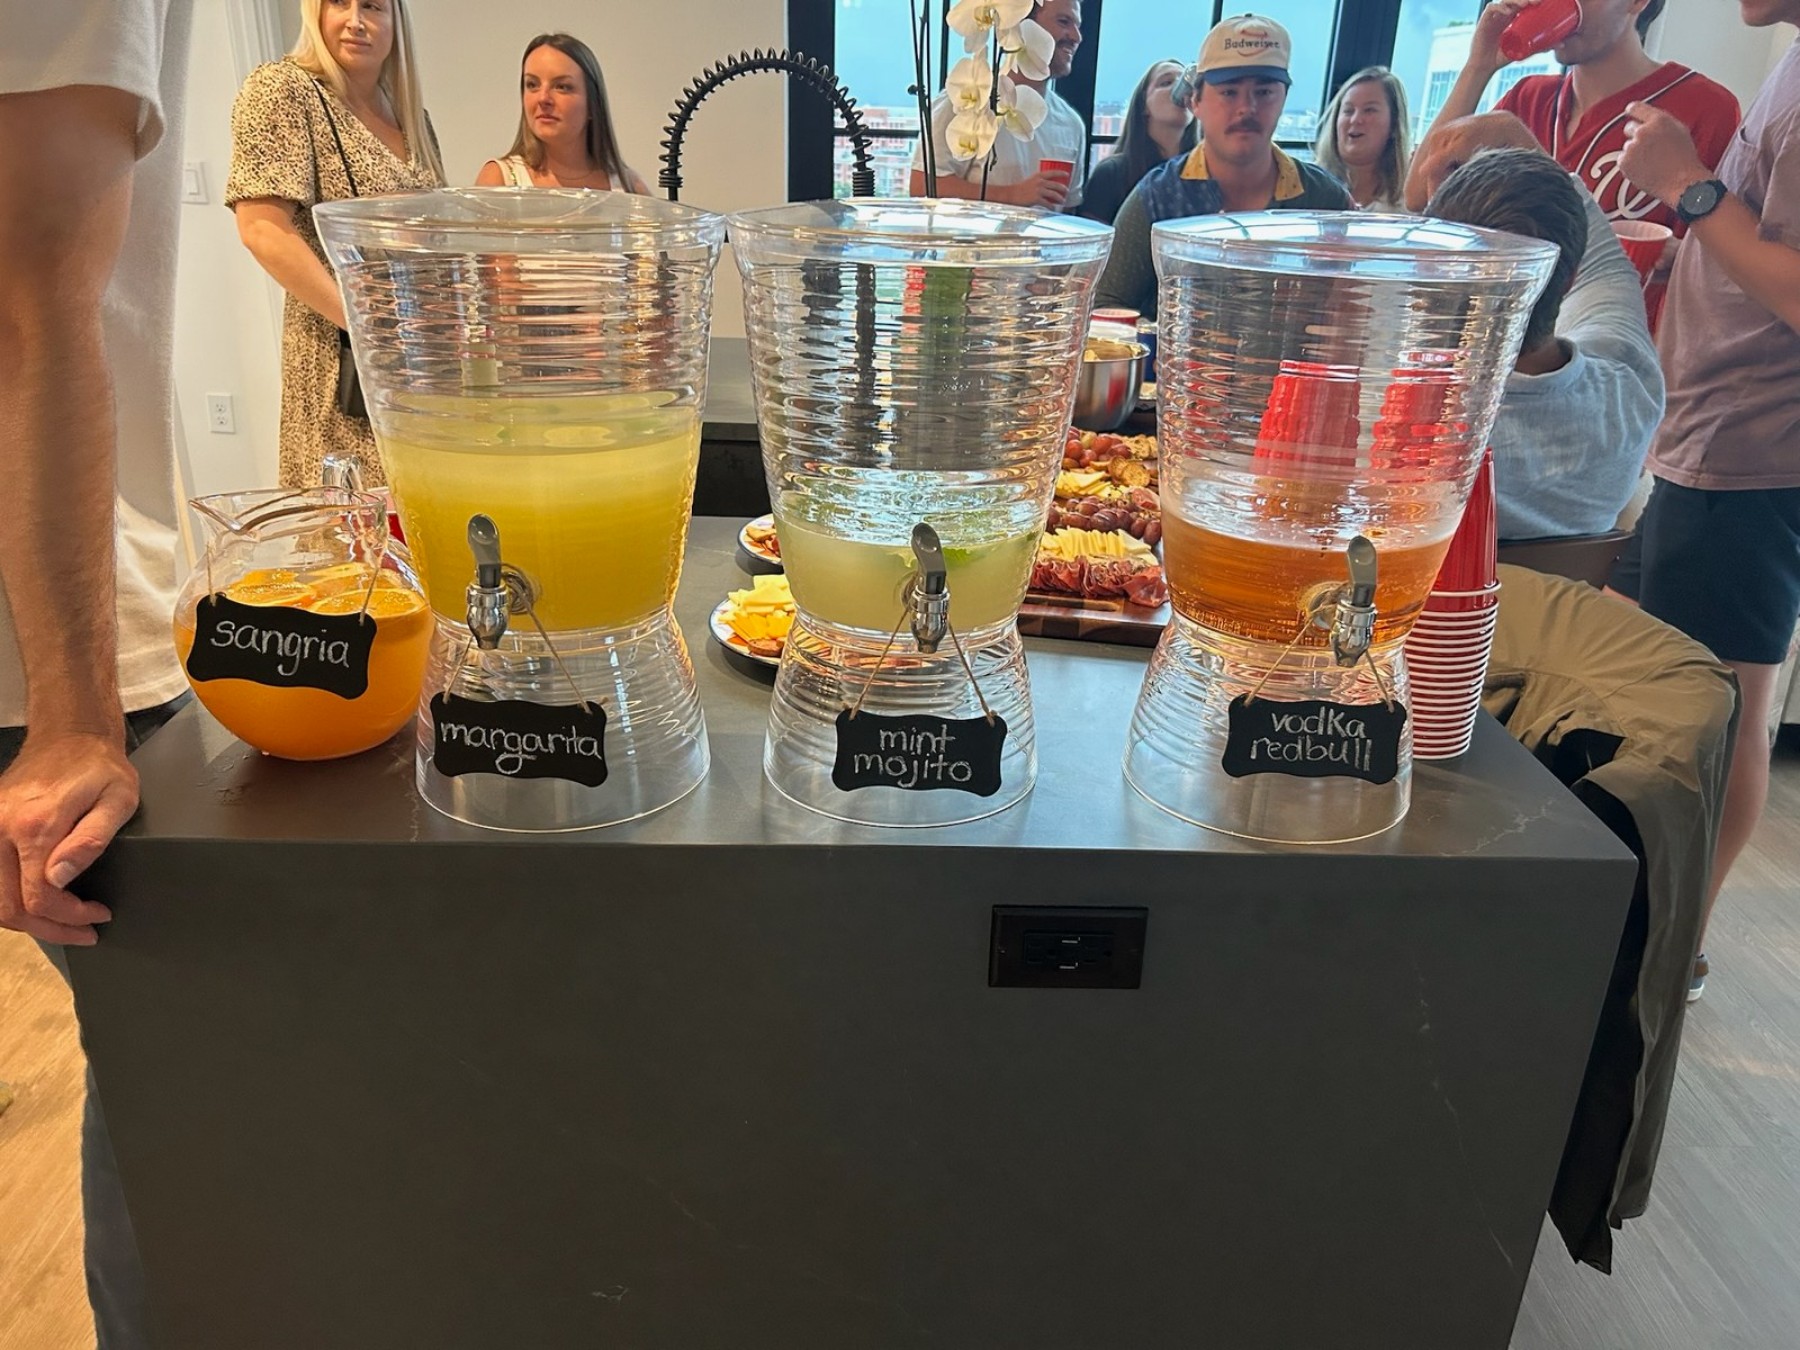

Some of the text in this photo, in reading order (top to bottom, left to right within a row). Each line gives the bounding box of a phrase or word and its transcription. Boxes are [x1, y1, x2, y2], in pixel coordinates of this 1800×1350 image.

[210, 620, 349, 676] sangria
[440, 721, 602, 775] margarita
[879, 723, 956, 755] mint
[1250, 734, 1372, 772] redbull
[853, 752, 972, 788] mojito
